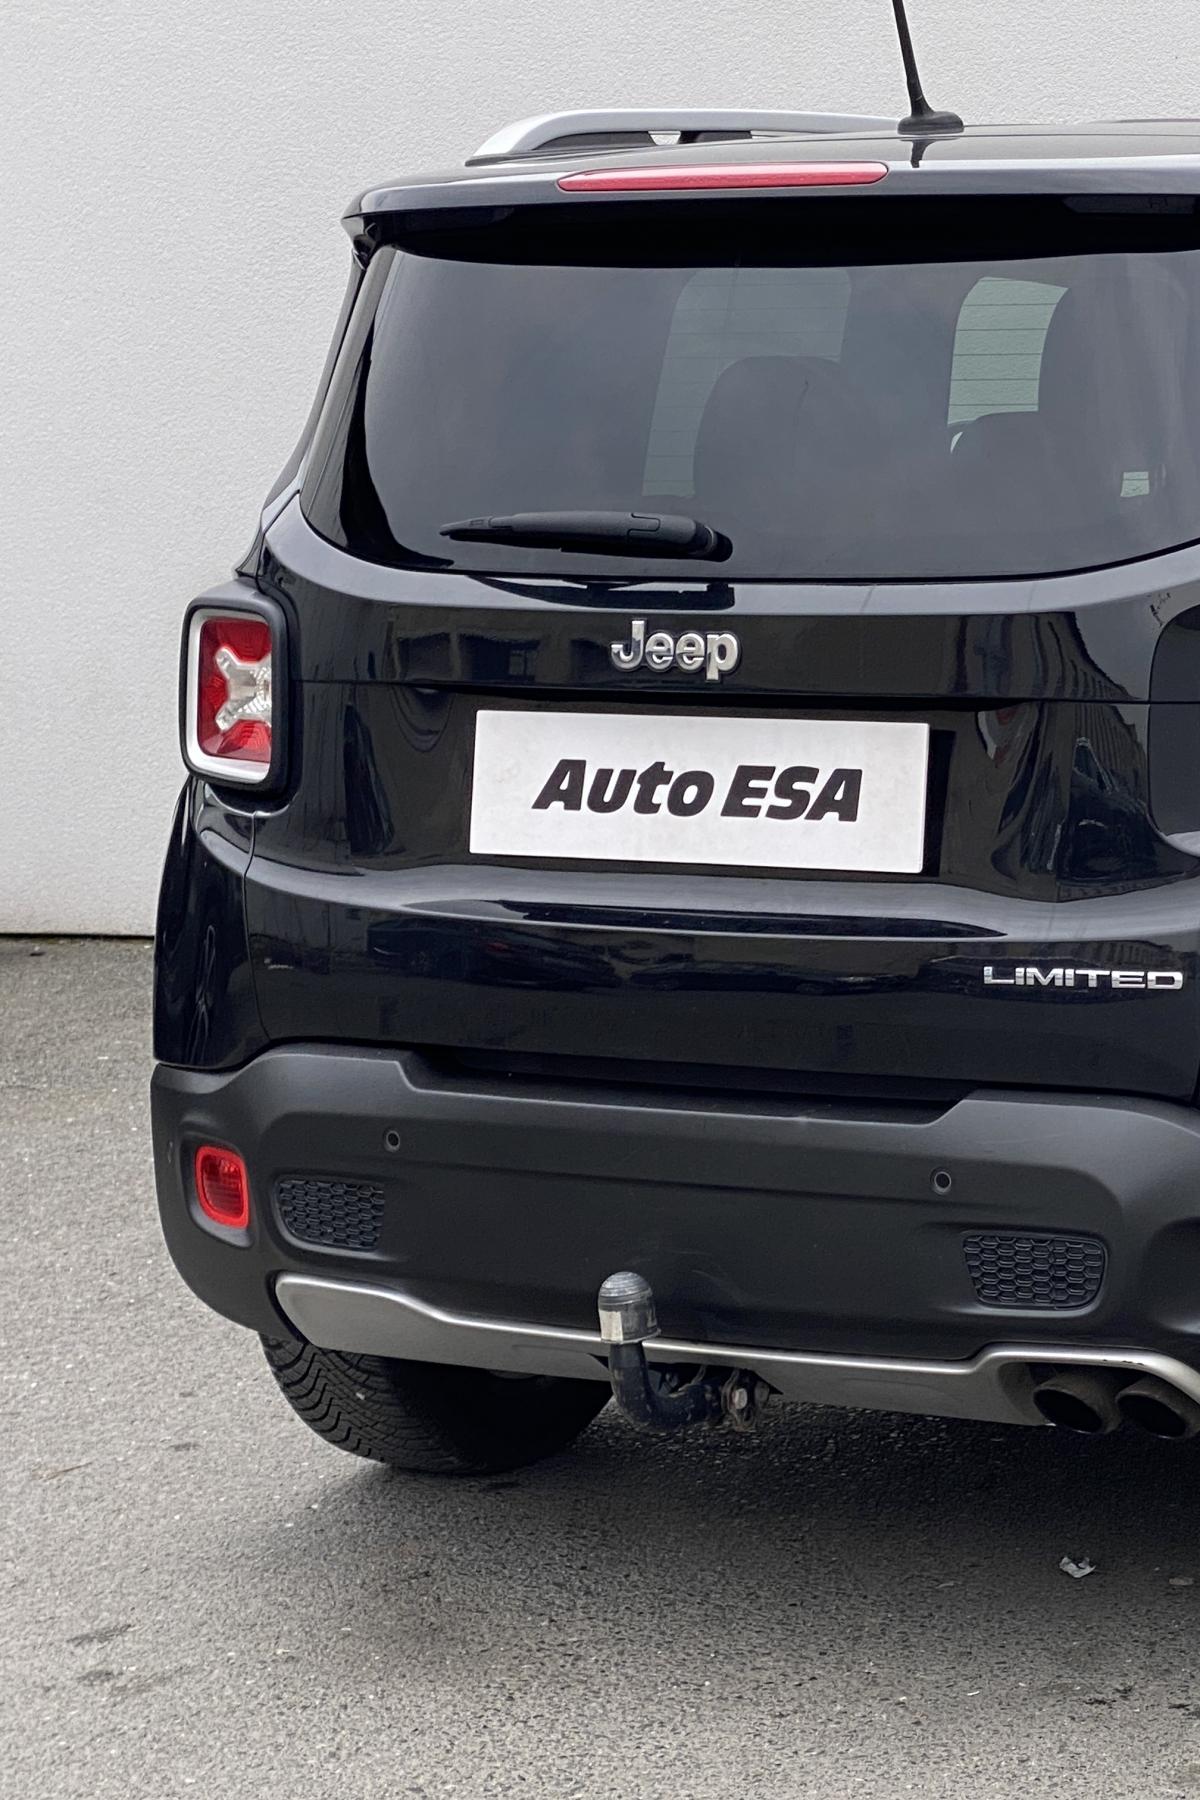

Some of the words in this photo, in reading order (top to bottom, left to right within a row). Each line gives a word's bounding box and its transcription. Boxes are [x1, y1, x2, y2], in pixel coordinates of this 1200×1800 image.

[610, 619, 740, 681] Jeep
[531, 759, 715, 817] Auto
[720, 765, 863, 823] ESA
[983, 966, 1183, 989] LIMITED
